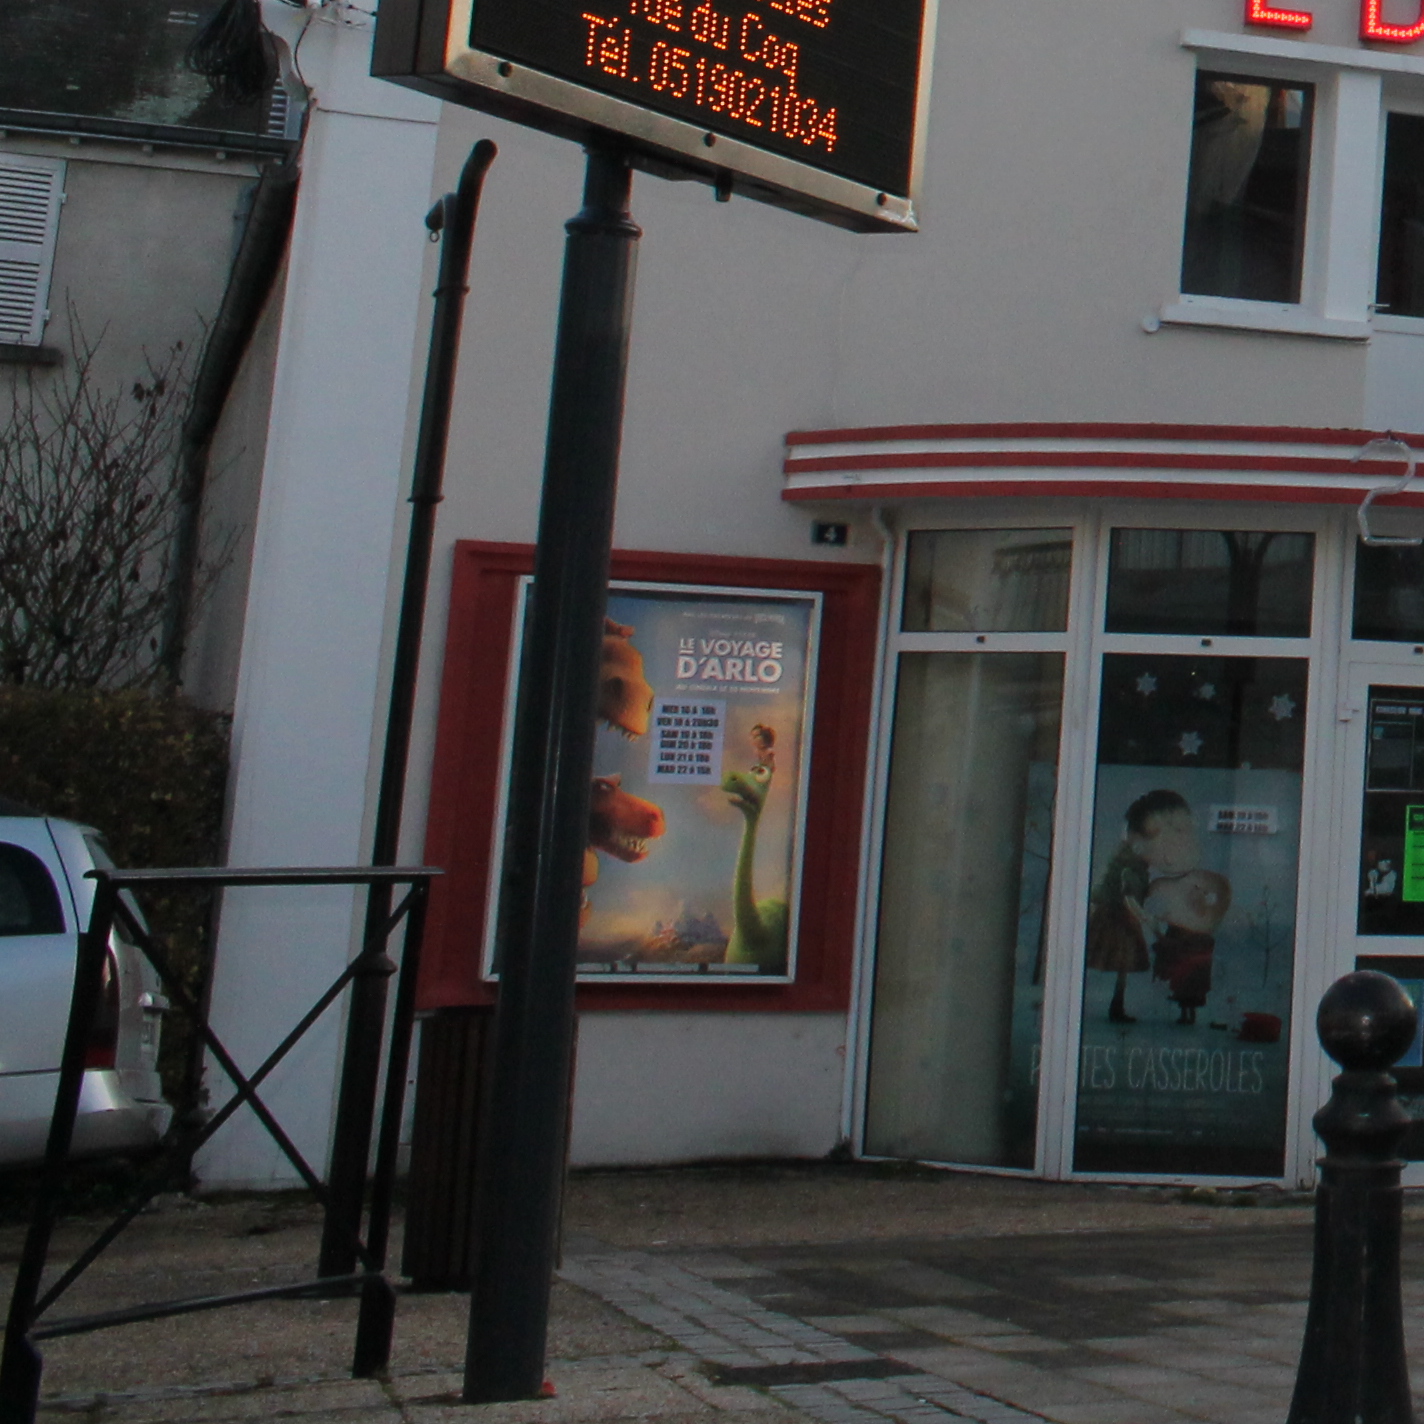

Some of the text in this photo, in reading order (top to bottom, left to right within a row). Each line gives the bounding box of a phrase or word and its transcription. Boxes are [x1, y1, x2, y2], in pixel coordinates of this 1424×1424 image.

[739, 11, 799, 91] Coq
[580, 12, 839, 153] Tél. 0519021034
[677, 656, 783, 683] D'ARLO
[680, 637, 783, 659] LE VOYAGE
[1128, 1047, 1264, 1094] CASSEROLES
